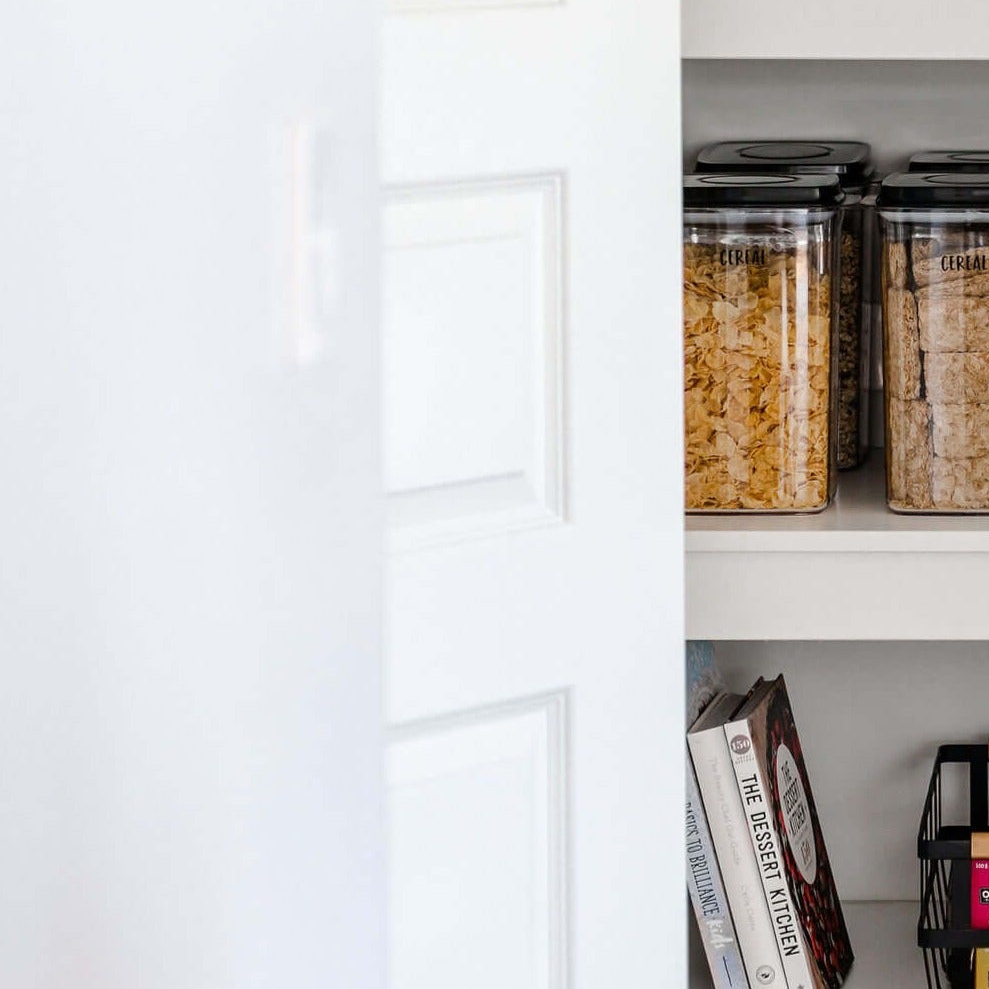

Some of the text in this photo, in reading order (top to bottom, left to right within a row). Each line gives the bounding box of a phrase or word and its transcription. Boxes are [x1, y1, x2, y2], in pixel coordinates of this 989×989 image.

[719, 249, 767, 267] CEREAL
[941, 254, 988, 272] CEREAL
[741, 773, 763, 806] THE
[687, 838, 703, 852] TO
[750, 811, 782, 880] DESSERT
[688, 854, 720, 917] BRILLIANCE
[769, 888, 800, 957] KITCHEN
